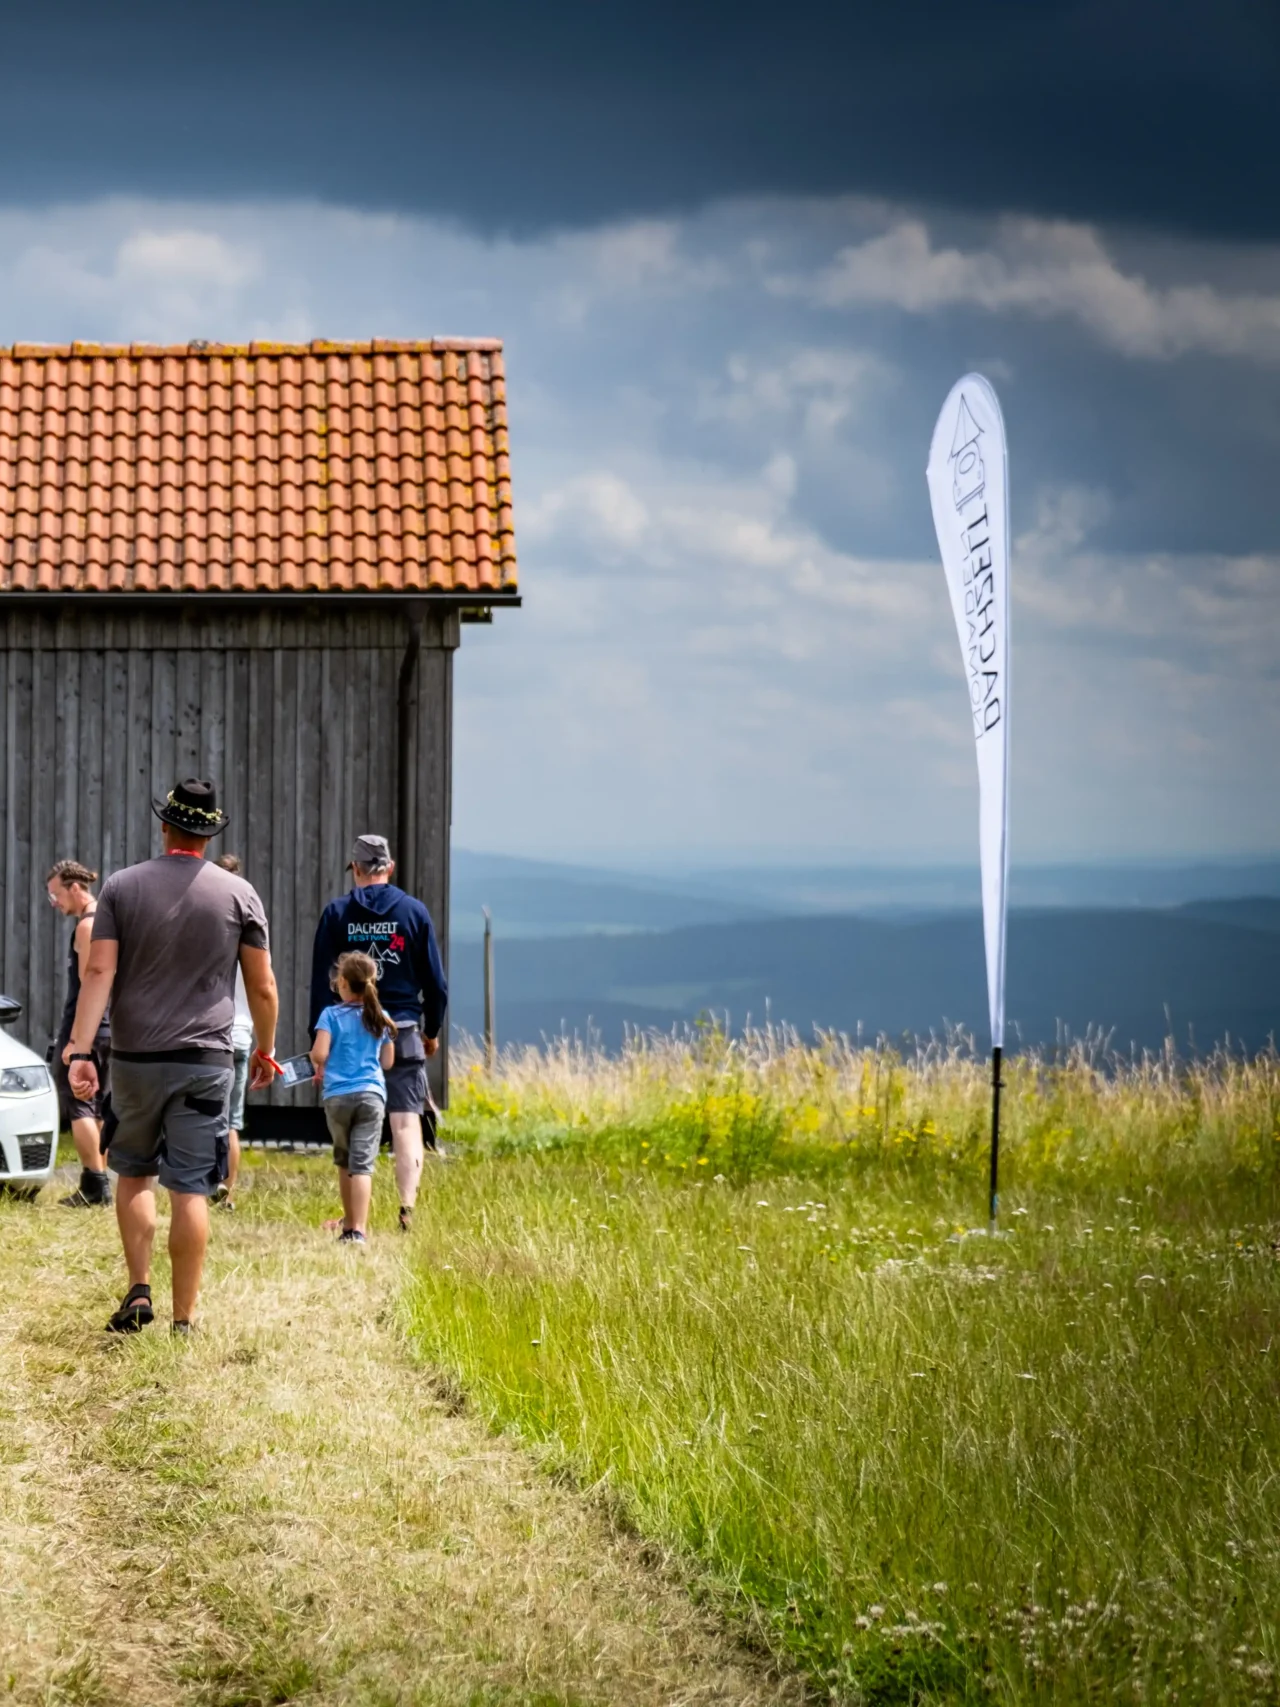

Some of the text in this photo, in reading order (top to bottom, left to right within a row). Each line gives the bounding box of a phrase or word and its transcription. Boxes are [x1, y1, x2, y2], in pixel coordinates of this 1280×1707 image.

[347, 922, 399, 935] DACHZELT
[347, 933, 405, 952] FESTIVAL 24
